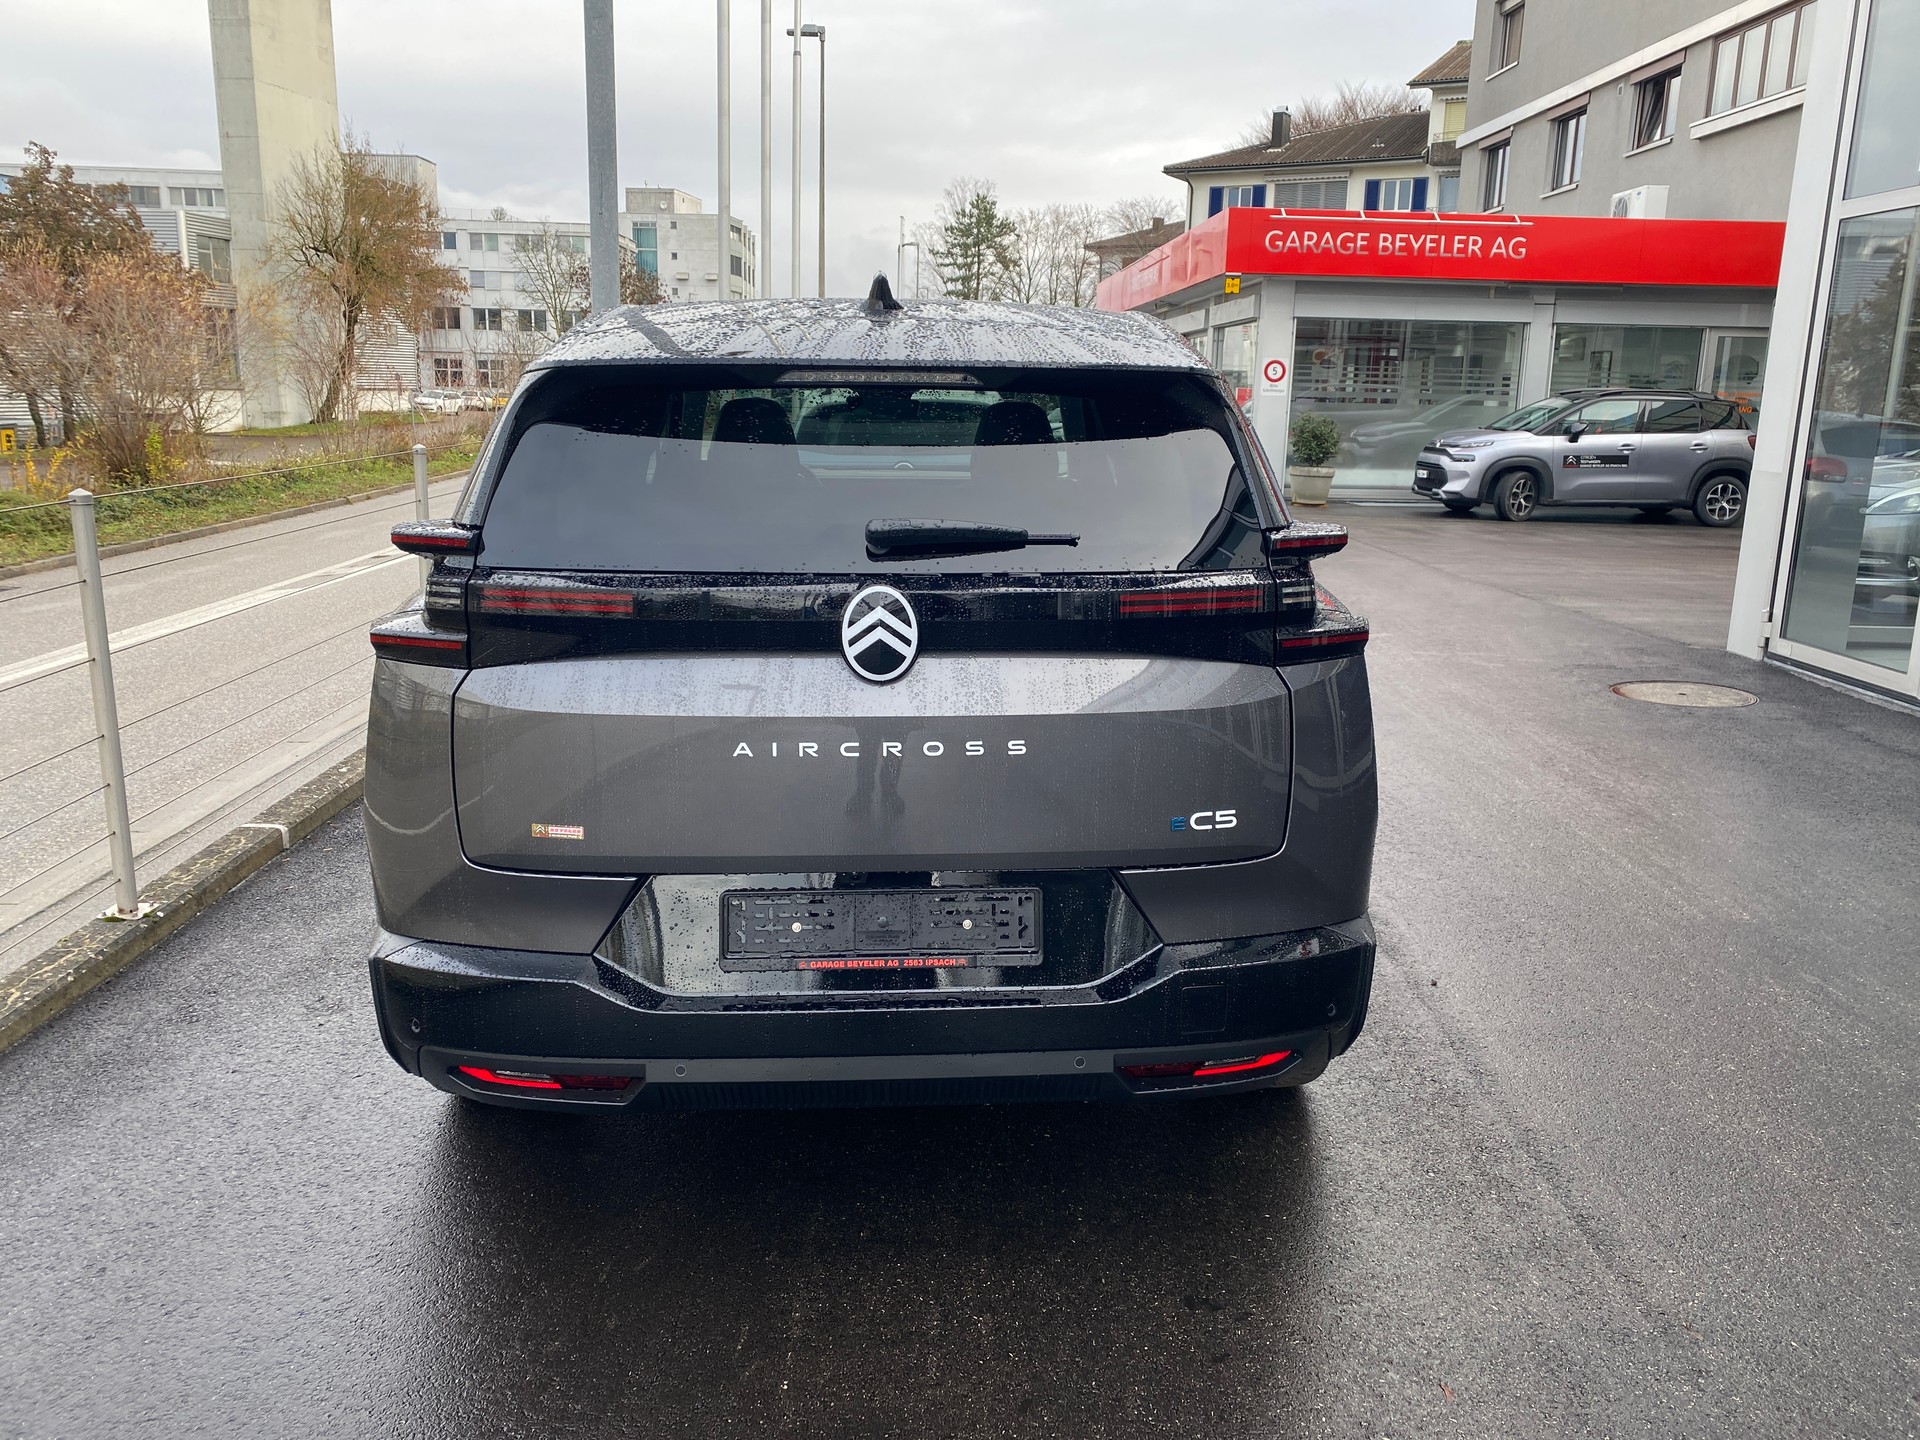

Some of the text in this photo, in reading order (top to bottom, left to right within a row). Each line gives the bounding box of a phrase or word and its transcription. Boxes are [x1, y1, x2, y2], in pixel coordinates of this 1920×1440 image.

[1265, 230, 1527, 259] GARAGE BEYELER AG
[1272, 366, 1278, 376] 5
[732, 740, 1027, 757] AIRCROSS
[810, 960, 845, 968] GARAGE
[847, 960, 885, 968] BEYELER
[887, 959, 899, 967] AG
[925, 959, 956, 967] IPSACH
